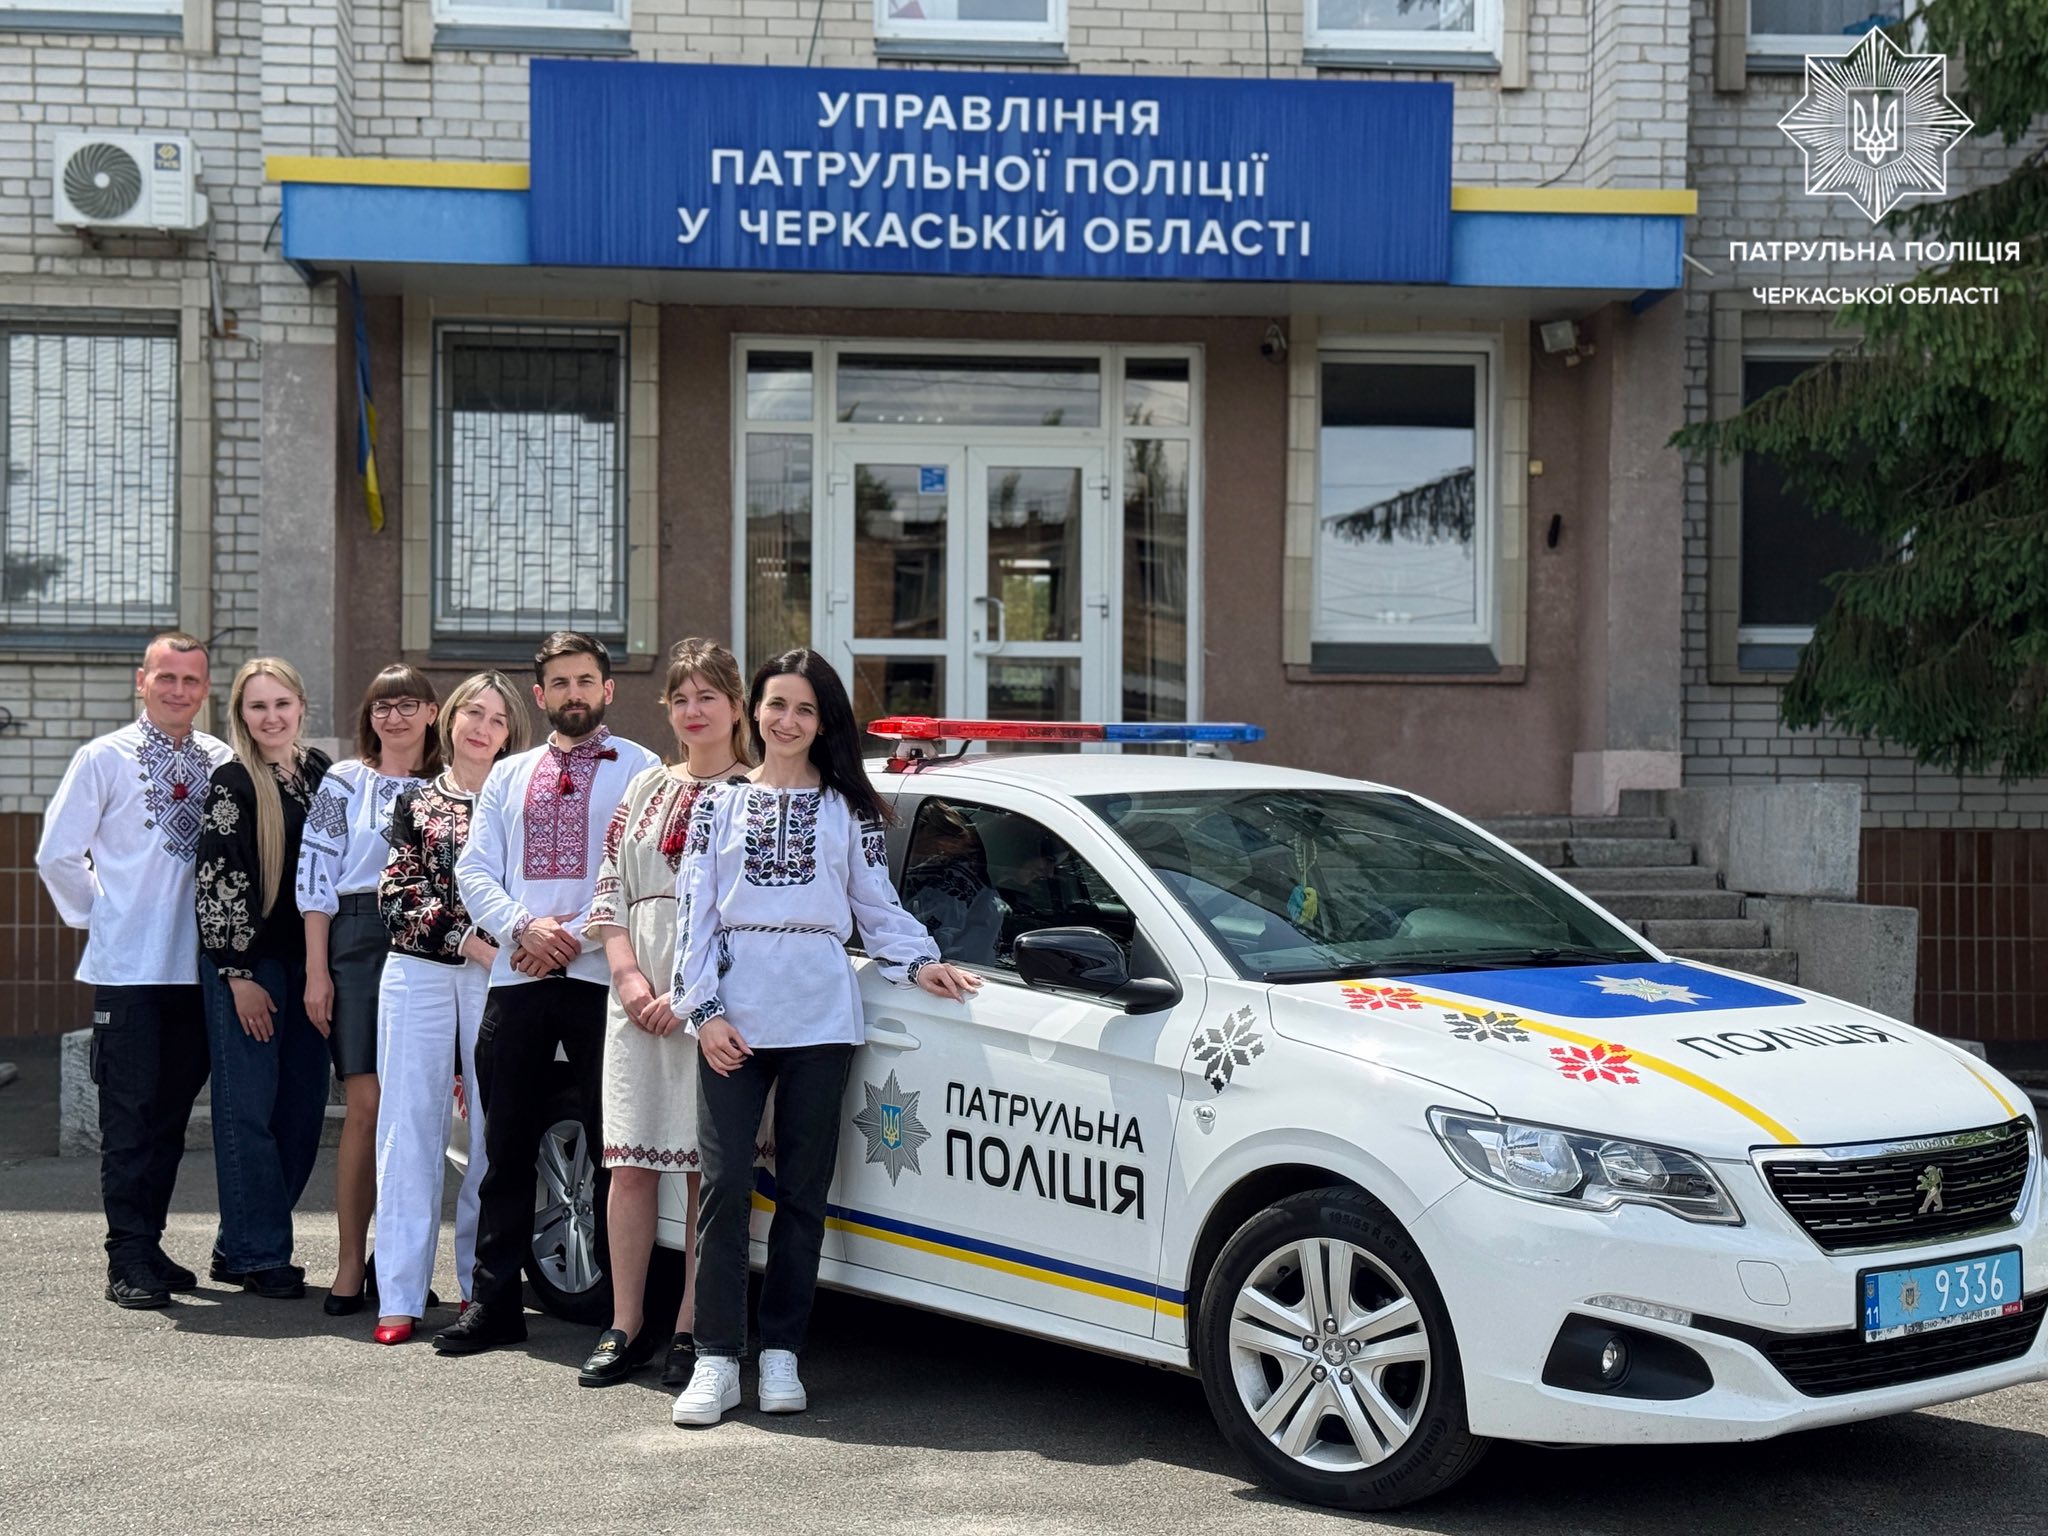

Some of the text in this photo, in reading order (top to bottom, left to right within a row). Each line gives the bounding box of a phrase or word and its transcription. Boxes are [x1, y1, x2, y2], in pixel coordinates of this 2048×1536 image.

[817, 91, 1161, 138] УПРАВЛІННЯ
[710, 146, 1269, 203] ПАТРУЛЬНОЇ ПОЛІЦІЇ
[675, 207, 1312, 258] У ЧЕРКАСЬКІЙ ОБЛАСТІ
[1677, 1025, 1908, 1059] ПОЛІЦІЯ
[946, 1080, 1145, 1154] ПАТРУЛЬНА
[946, 1128, 1145, 1221] ПОЛІЦІЯ
[1865, 1259, 2004, 1325] 11 9336
